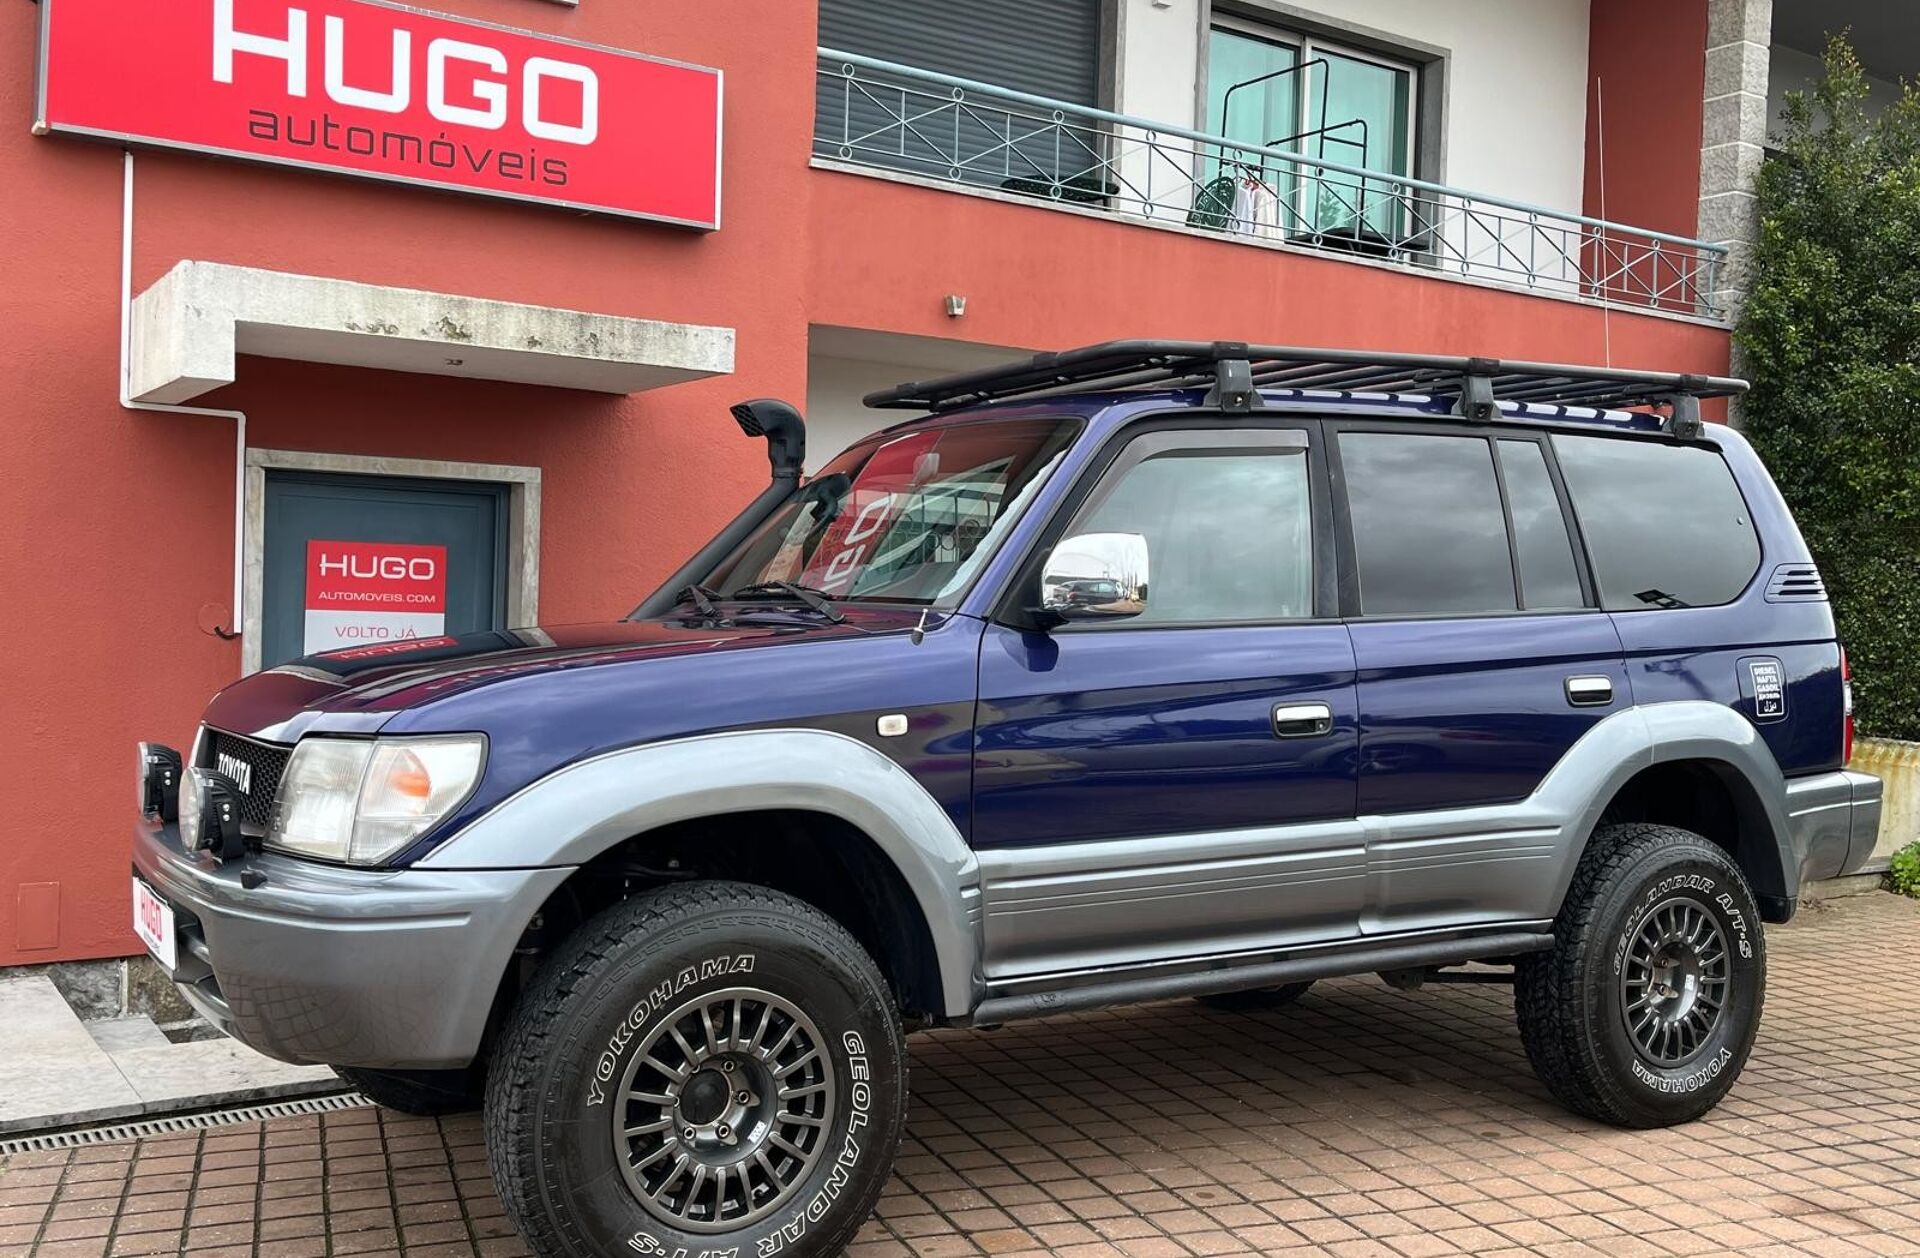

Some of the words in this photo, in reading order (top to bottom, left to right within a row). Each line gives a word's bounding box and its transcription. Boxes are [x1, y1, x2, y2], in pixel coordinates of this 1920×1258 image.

[212, 0, 599, 145] HUGO
[248, 109, 568, 187] automóveis
[319, 553, 435, 580] HUGO
[335, 626, 389, 639] VOLTO
[394, 624, 417, 639] JÁ
[218, 752, 251, 795] TOYOTA
[587, 954, 756, 1107] YOKOHAMA
[1631, 1046, 1733, 1094] YOKOHAMA
[756, 1030, 871, 1258] GEOLANDAR
